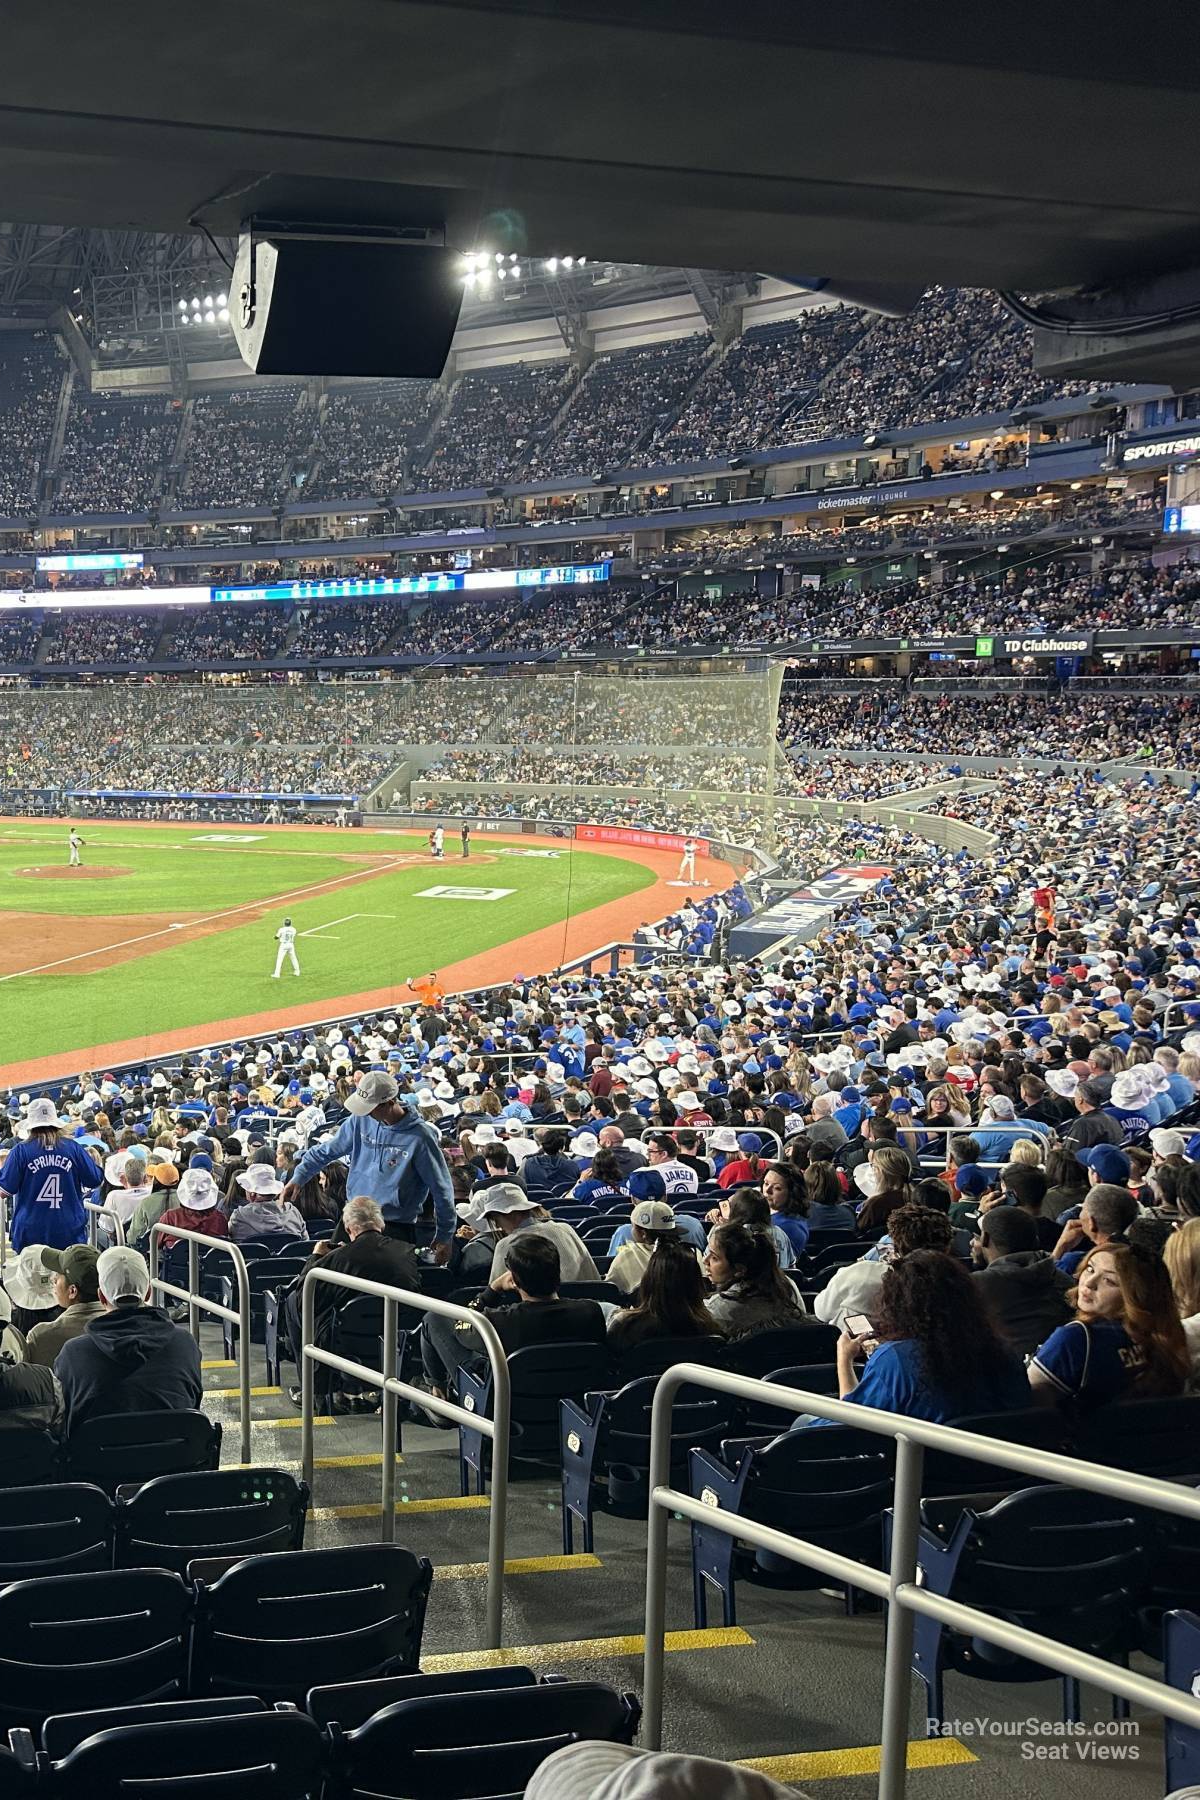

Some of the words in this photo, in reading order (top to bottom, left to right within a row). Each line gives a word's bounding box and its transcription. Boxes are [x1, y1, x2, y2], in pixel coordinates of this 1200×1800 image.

[817, 496, 872, 510] ticketmaster
[881, 491, 908, 501] LOUNGE
[1004, 640, 1021, 652] TD
[1022, 639, 1088, 651] Clubhouse
[486, 822, 500, 830] BET
[27, 1154, 73, 1174] SPRINGER
[664, 1169, 694, 1183] JANSEN
[35, 1173, 64, 1209] 4
